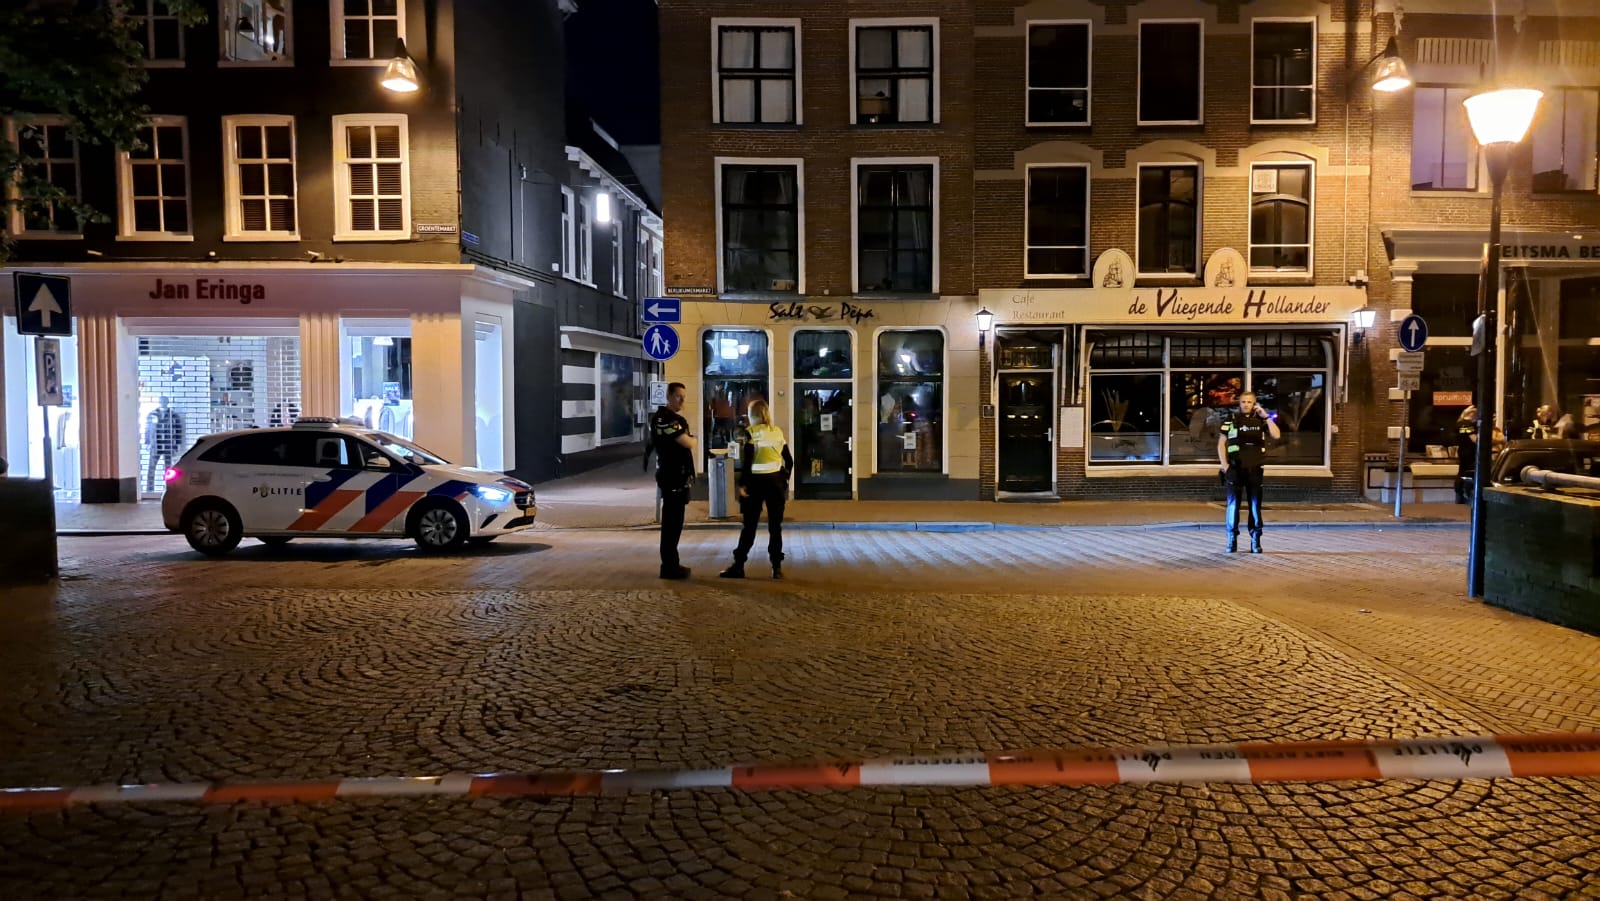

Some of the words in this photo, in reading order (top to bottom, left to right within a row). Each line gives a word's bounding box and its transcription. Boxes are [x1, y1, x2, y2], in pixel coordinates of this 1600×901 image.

[1579, 245, 1600, 258] BE
[149, 278, 189, 299] Jan
[196, 278, 265, 304] Eringa
[769, 302, 803, 319] Salt
[1128, 296, 1146, 315] de
[1156, 288, 1234, 320] Vliegende
[1242, 289, 1331, 319] Hollander
[1013, 310, 1065, 320] Restaurant
[252, 486, 303, 497] POLITIE
